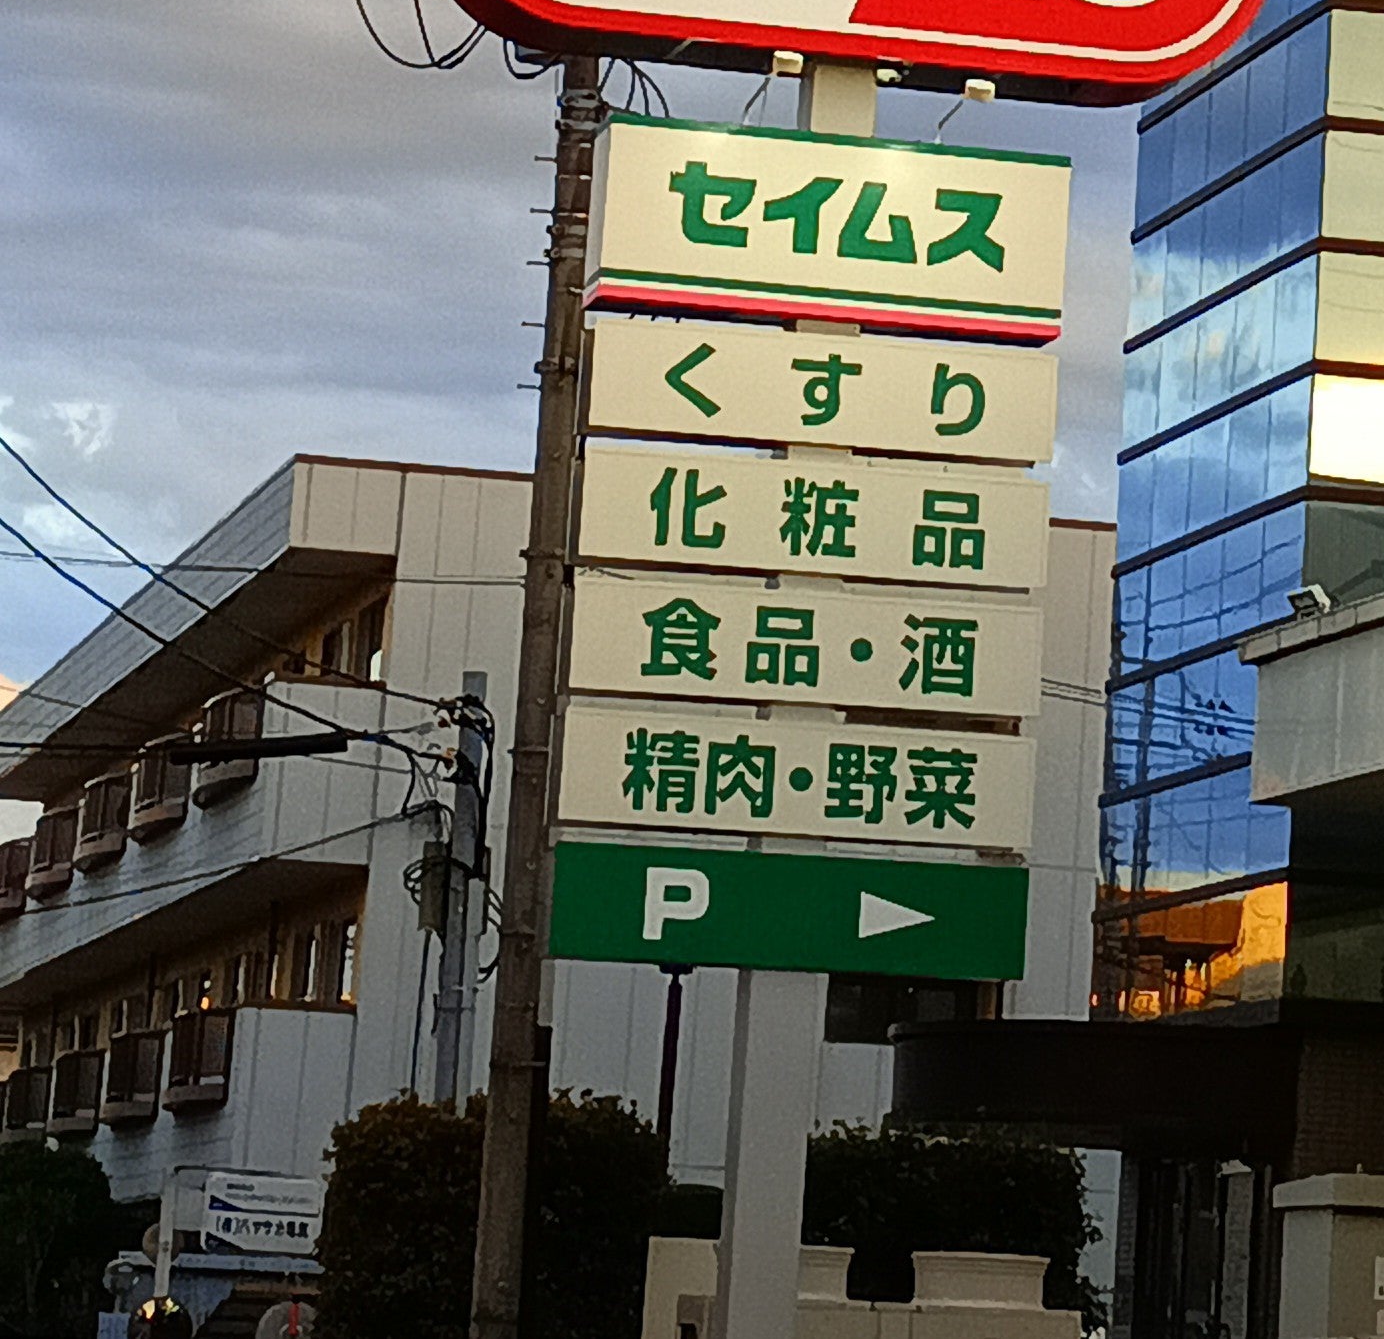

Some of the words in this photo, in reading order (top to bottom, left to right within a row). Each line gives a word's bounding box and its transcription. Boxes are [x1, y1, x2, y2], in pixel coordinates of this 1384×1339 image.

[669, 160, 1004, 274] セイムス
[663, 342, 986, 437] くすり
[650, 467, 986, 571] 化粧品
[640, 597, 978, 698] 食品・酒
[622, 728, 978, 829] 精肉・野菜
[642, 866, 710, 941] P
